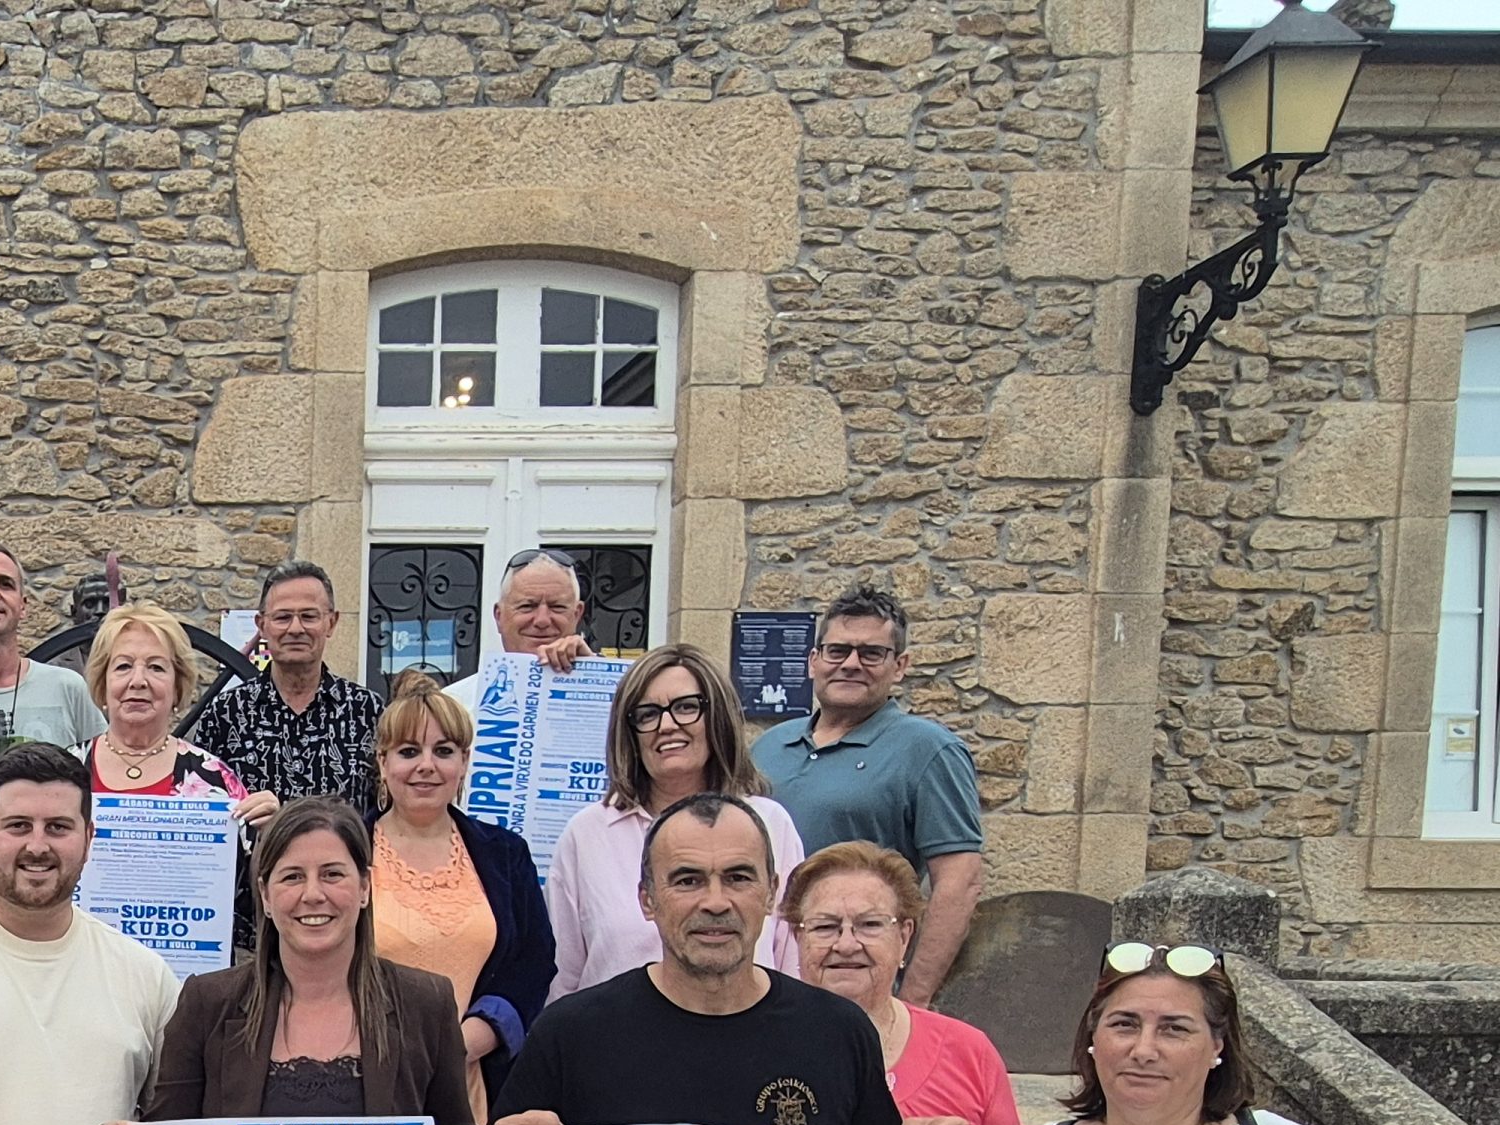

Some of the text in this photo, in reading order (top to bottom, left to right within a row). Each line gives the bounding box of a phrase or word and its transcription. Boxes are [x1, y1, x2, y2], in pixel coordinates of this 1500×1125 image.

[521, 692, 540, 740] CARMEN
[520, 741, 534, 758] DO
[516, 760, 532, 792] VIRXE
[514, 793, 527, 802] A
[96, 814, 228, 826] GRAN MEXILLONADA POPULAR
[510, 803, 526, 834] ONRA
[121, 904, 216, 922] SUPERTOP
[121, 920, 188, 937] KUBO
